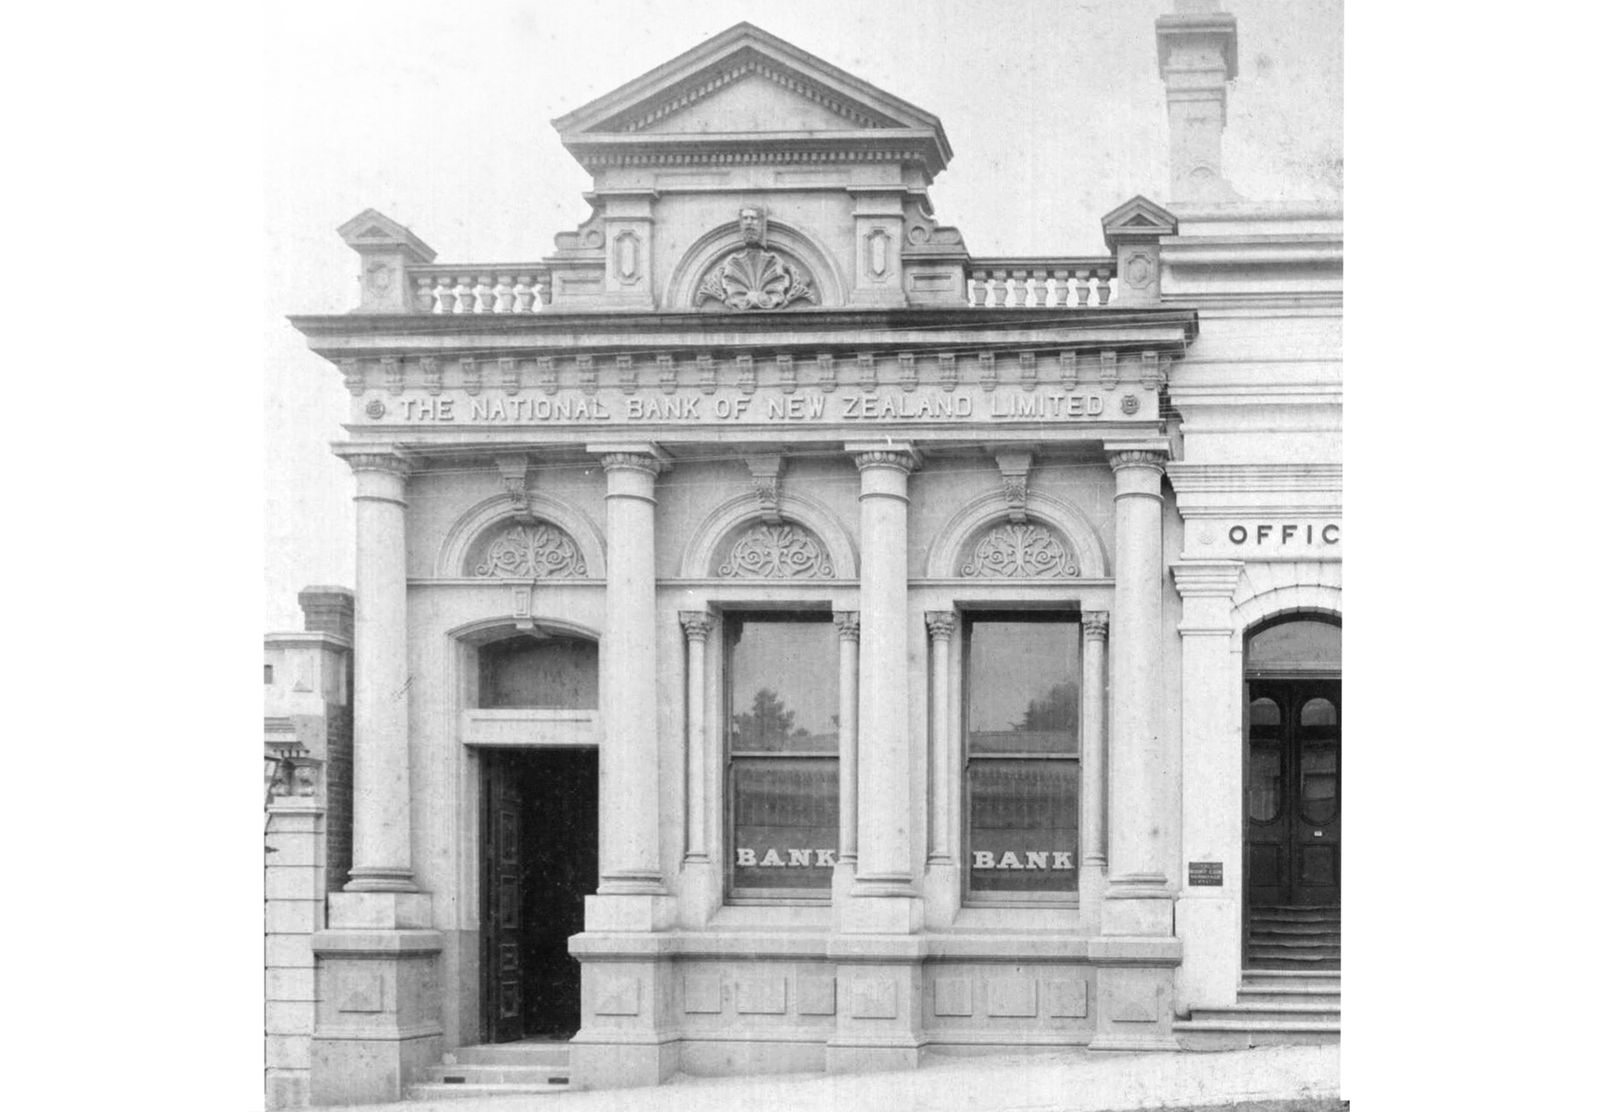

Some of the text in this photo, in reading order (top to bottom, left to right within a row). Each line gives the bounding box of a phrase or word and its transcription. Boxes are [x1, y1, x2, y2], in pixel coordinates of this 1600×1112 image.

[401, 395, 1103, 420] THE NATIONAL BANK OF NEW ZEALAND LIMITED
[1228, 524, 1340, 545] OFFIC
[736, 848, 838, 867] BANK
[972, 850, 1075, 870] BANK
